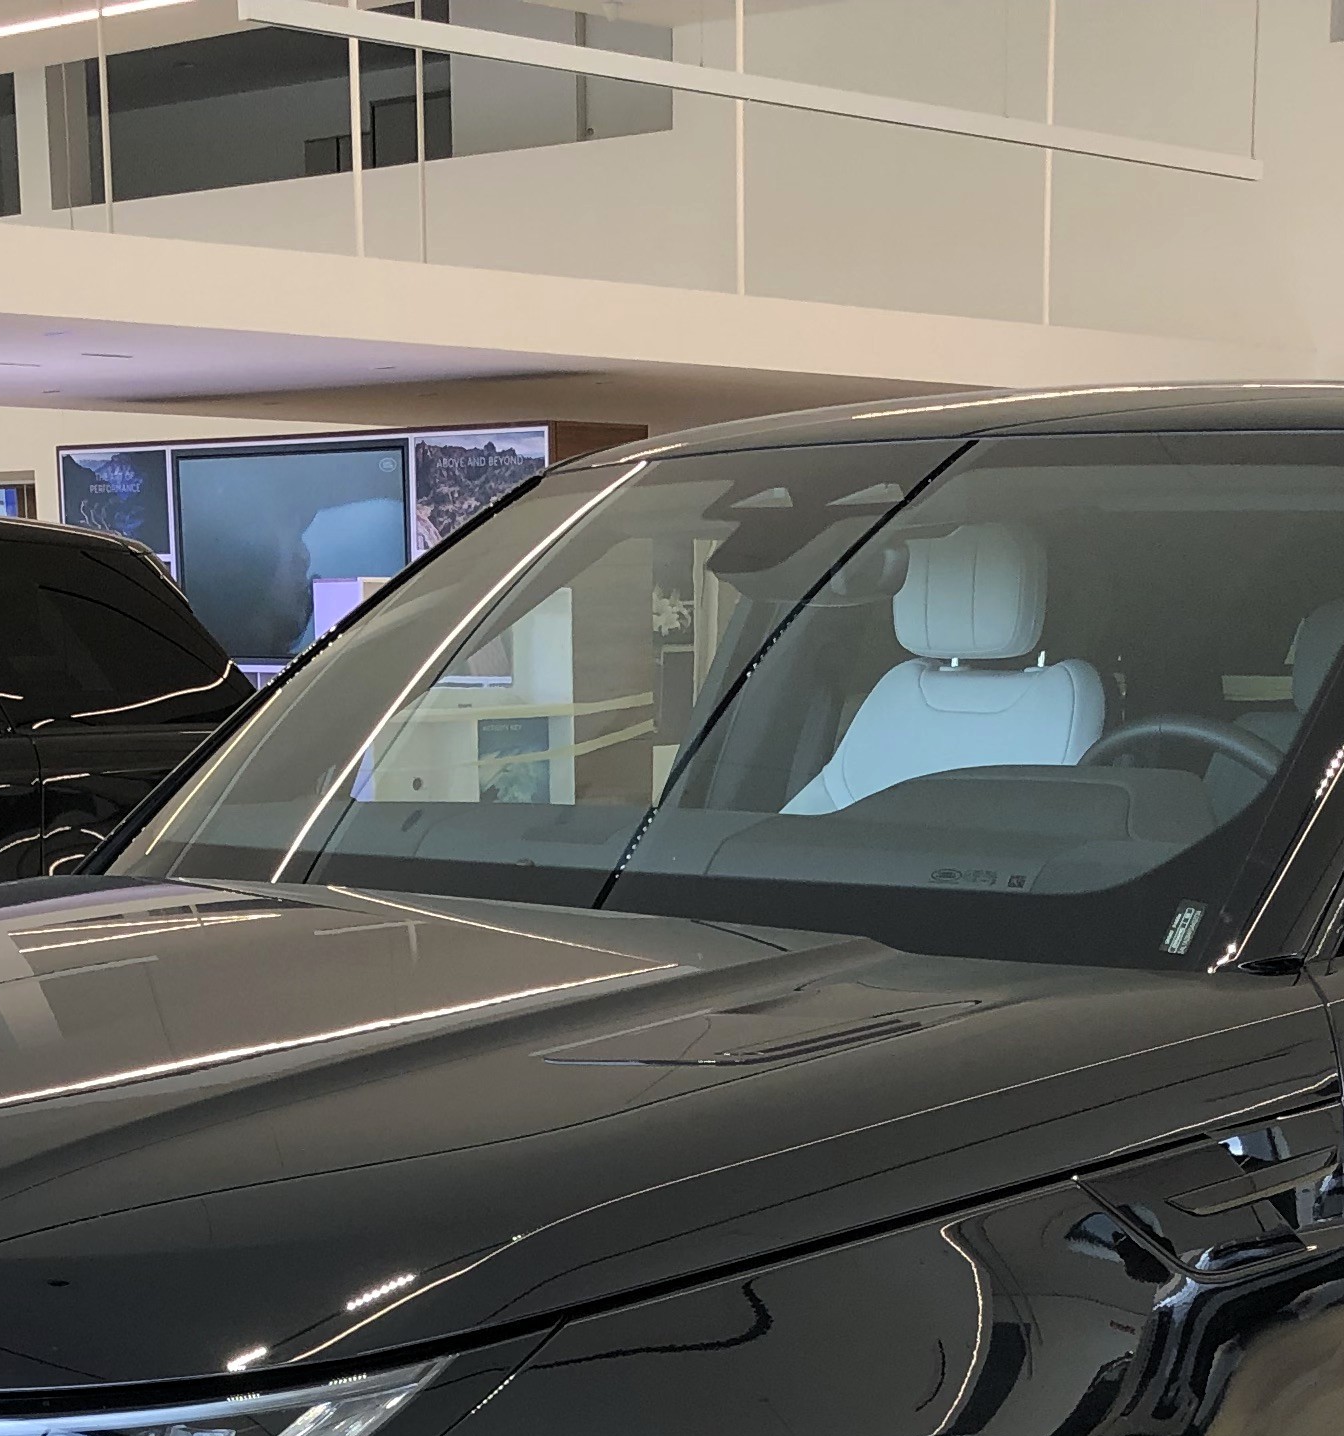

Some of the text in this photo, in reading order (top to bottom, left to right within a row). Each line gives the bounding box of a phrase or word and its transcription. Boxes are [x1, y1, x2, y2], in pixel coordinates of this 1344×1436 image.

[436, 454, 524, 468] ABOVE AND BEYOND
